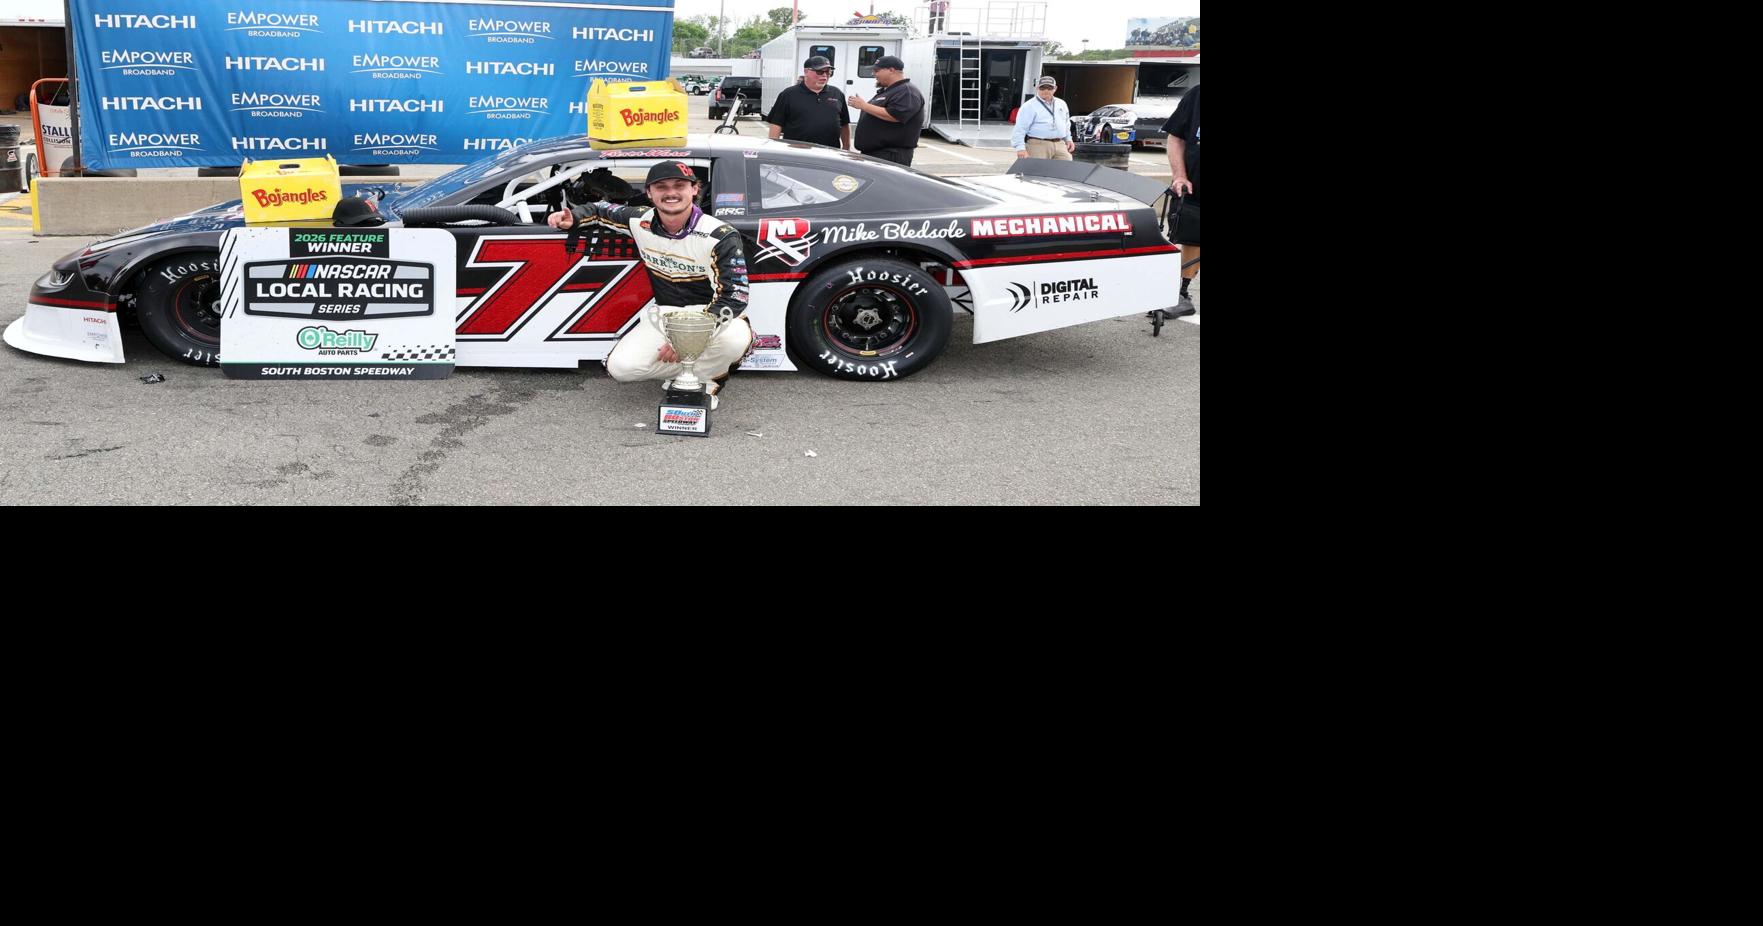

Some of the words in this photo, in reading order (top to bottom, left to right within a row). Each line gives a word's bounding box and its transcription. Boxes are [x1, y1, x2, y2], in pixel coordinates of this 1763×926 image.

[94, 14, 196, 29] HITACHI
[227, 11, 319, 27] EMPOWER
[469, 18, 551, 33] EMPOWER
[247, 30, 301, 38] BROADBAND
[348, 20, 443, 35] HITACHI
[572, 27, 654, 42] HITACHI
[487, 36, 535, 44] BROADBAND
[101, 49, 193, 64] EMPOWER
[225, 56, 325, 71] HITACHI
[352, 53, 439, 68] EMPOWER
[466, 61, 555, 76] HITACHI
[574, 59, 648, 73] EMPOWER
[102, 96, 202, 111] HITACHI
[231, 91, 321, 107] EMPOWER
[349, 99, 444, 113] HITACHI
[469, 96, 548, 109] EMPOWER
[620, 108, 680, 127] Bojangles
[42, 124, 71, 137] STALL
[109, 132, 200, 146] EMPOWER
[231, 136, 327, 150] HITACHI
[354, 133, 437, 146] EMPOWER
[463, 138, 533, 150] HITAC
[251, 188, 327, 208] Bojangles
[822, 222, 879, 244] Mike
[880, 219, 966, 240] Bledsole
[971, 213, 1130, 237] MECHANICAL
[294, 234, 326, 243] 2026
[329, 234, 384, 243] FEATURE
[307, 243, 372, 253] WINNER
[160, 259, 220, 284] Hoosi
[314, 264, 392, 279] NASCAR
[455, 234, 660, 342] 77
[847, 267, 928, 295] Hoosier
[1040, 277, 1098, 295] DIGITAL
[256, 283, 332, 297] LOCAL
[338, 283, 424, 298] RACING
[1042, 290, 1099, 304] REPAIR
[318, 304, 361, 314] SERIES
[298, 326, 377, 350] O'Reilly
[261, 367, 301, 375] SOUTH
[302, 367, 352, 375] BOSTON
[353, 367, 415, 375] SPEEDWAY
[818, 350, 898, 378] Hoosier
